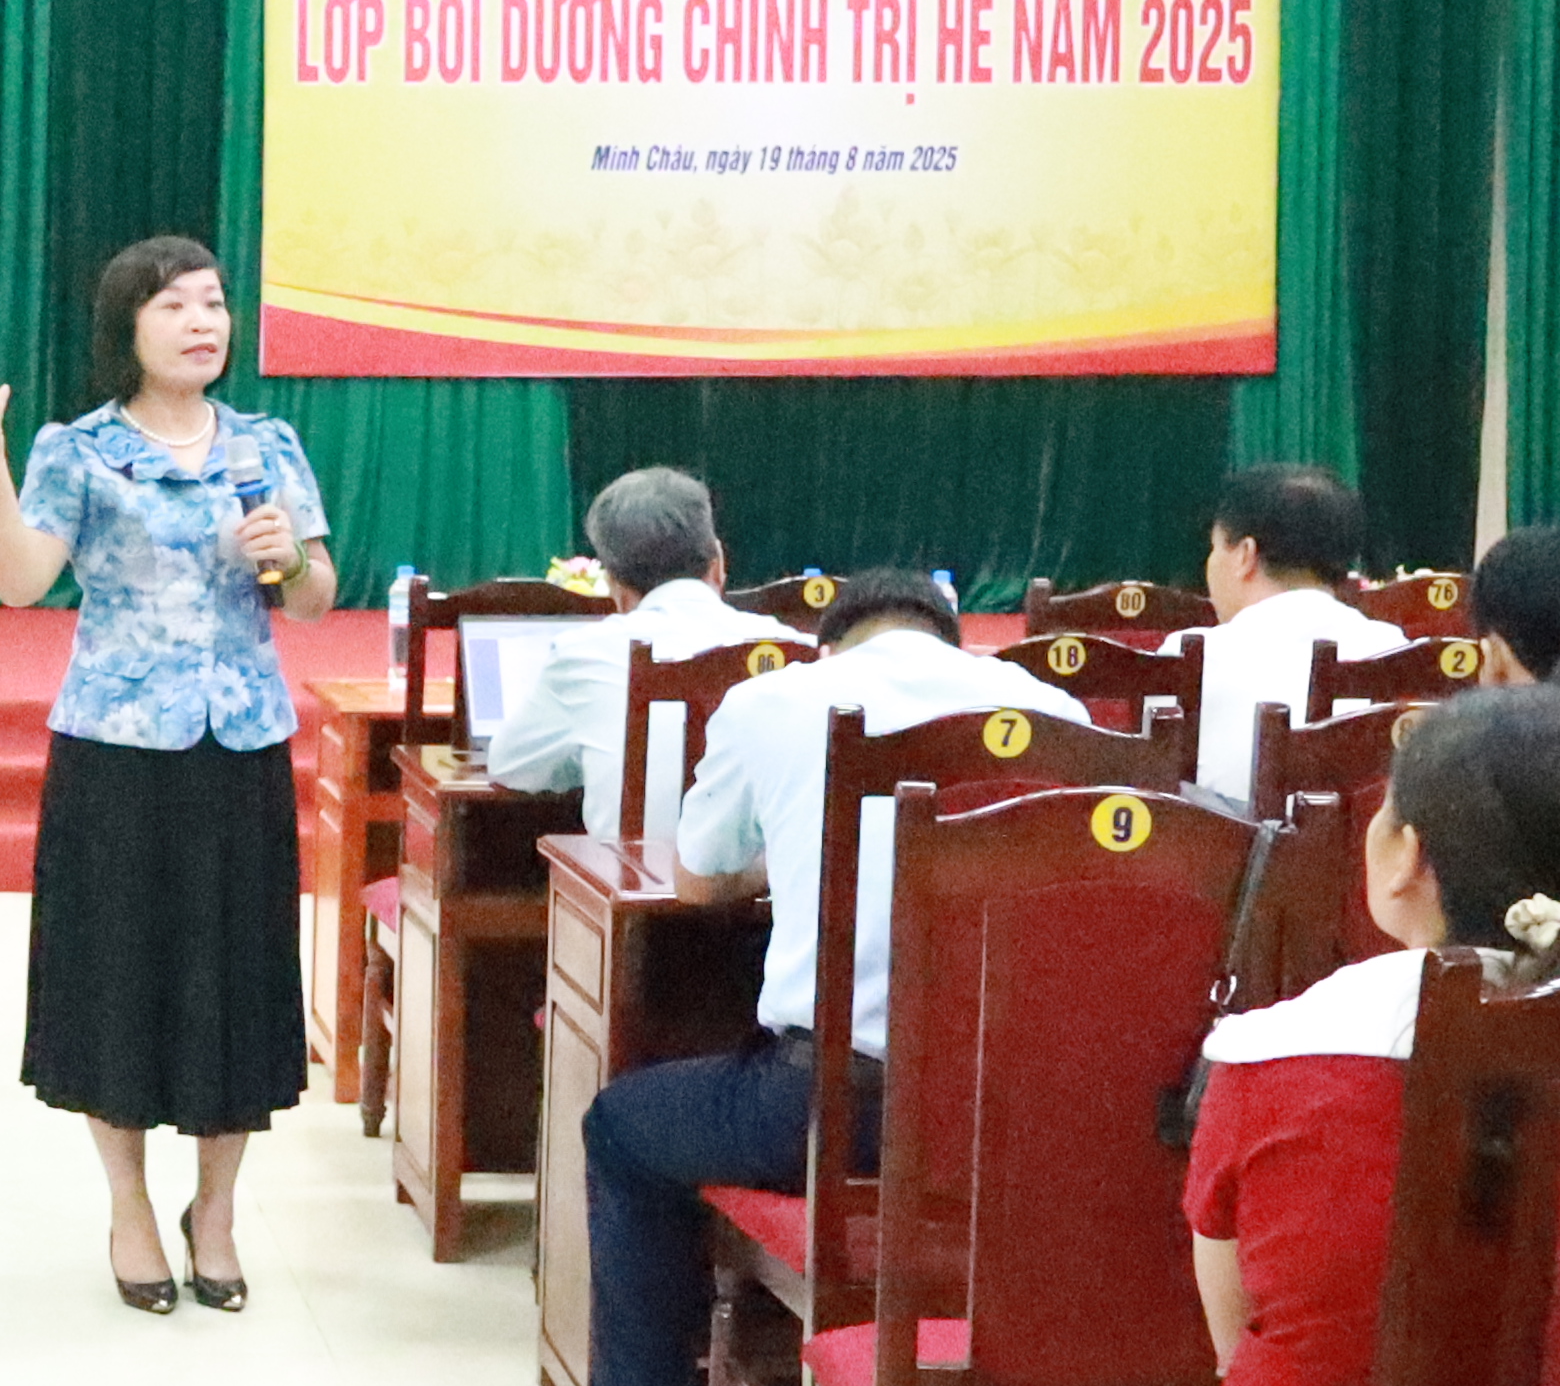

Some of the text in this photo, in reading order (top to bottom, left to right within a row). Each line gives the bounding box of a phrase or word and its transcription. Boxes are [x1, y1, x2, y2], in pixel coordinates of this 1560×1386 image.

[592, 144, 958, 174] Minh Châu, ngày 19 tháng 8 năm 2025
[813, 583, 825, 602] 3
[1120, 590, 1141, 611] 80
[1433, 583, 1453, 601] 76
[1053, 646, 1078, 666] 18
[1452, 651, 1465, 670] 2
[999, 720, 1015, 746] 7
[1112, 808, 1133, 841] 9
